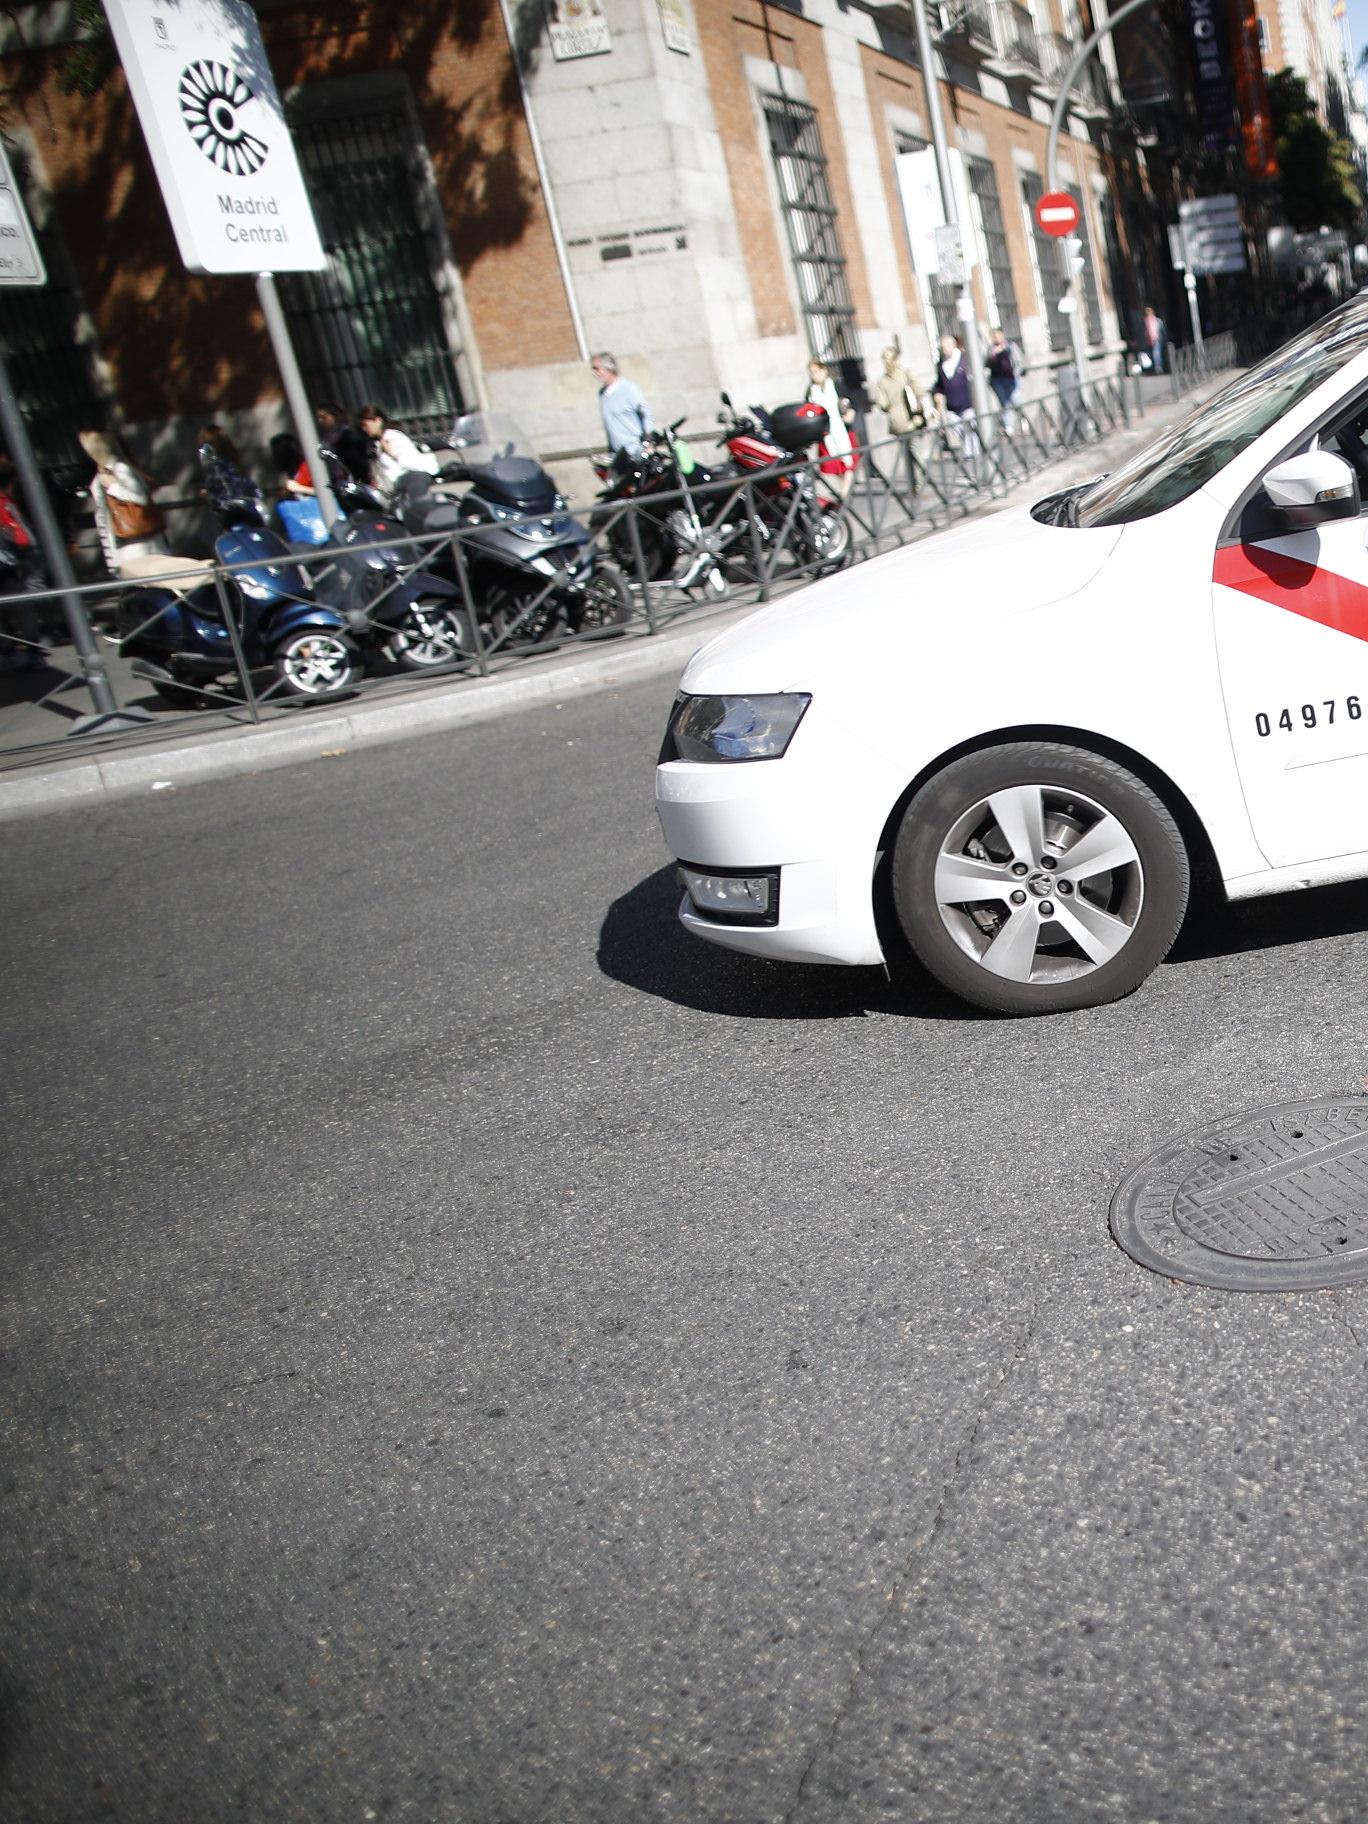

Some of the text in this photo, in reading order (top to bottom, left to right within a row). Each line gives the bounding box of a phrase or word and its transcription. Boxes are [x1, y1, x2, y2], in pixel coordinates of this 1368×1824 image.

[217, 194, 279, 215] Madrid
[225, 222, 288, 242] Central
[1255, 696, 1362, 737] 04976
